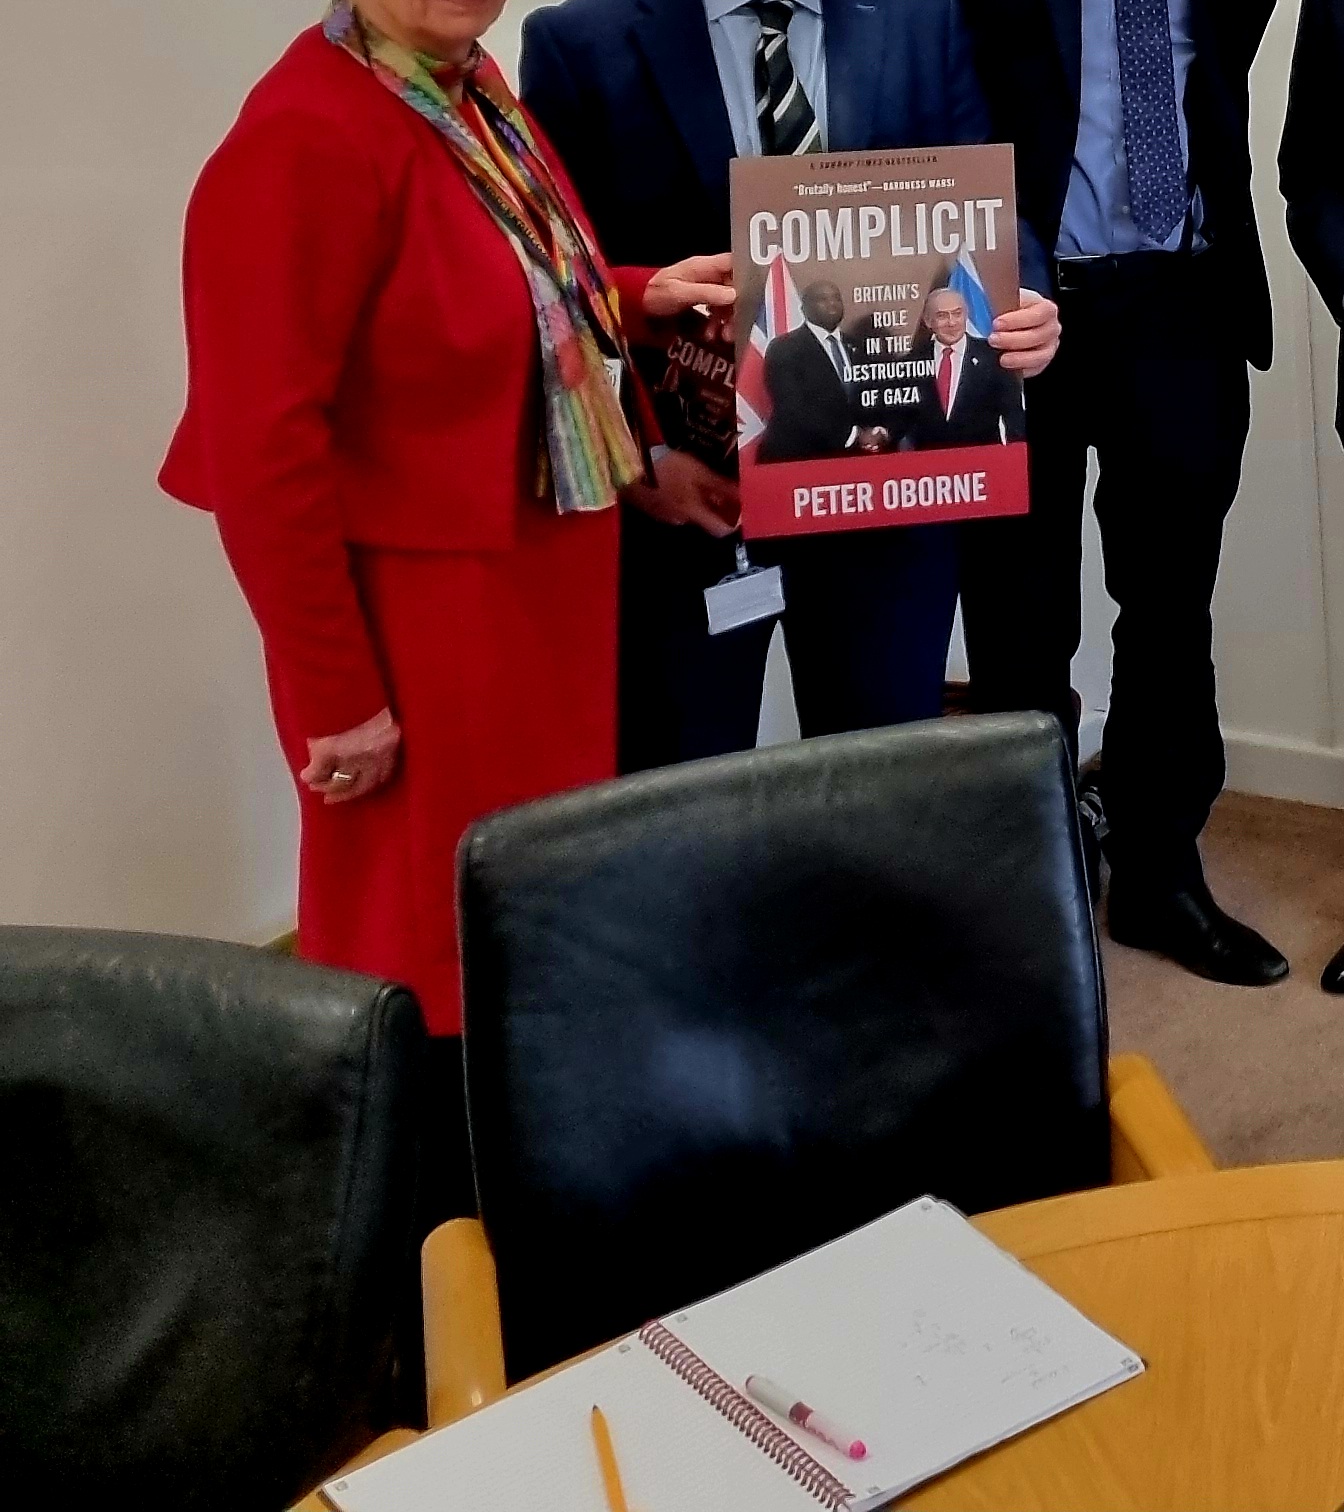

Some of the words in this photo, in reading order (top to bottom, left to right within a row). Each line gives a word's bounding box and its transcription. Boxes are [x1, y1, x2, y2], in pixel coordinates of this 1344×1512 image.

[749, 198, 1003, 266] COMPLICIT
[853, 283, 920, 303] BRITAIN'S
[873, 310, 908, 329] ROLE
[866, 338, 882, 355] IN
[885, 335, 911, 353] THE
[667, 335, 735, 389] COMPL
[843, 359, 935, 383] DESTRUCTION
[861, 389, 879, 407] OF
[883, 386, 920, 405] GAZA
[794, 482, 874, 518] PETER
[883, 471, 987, 510] OBORNE
